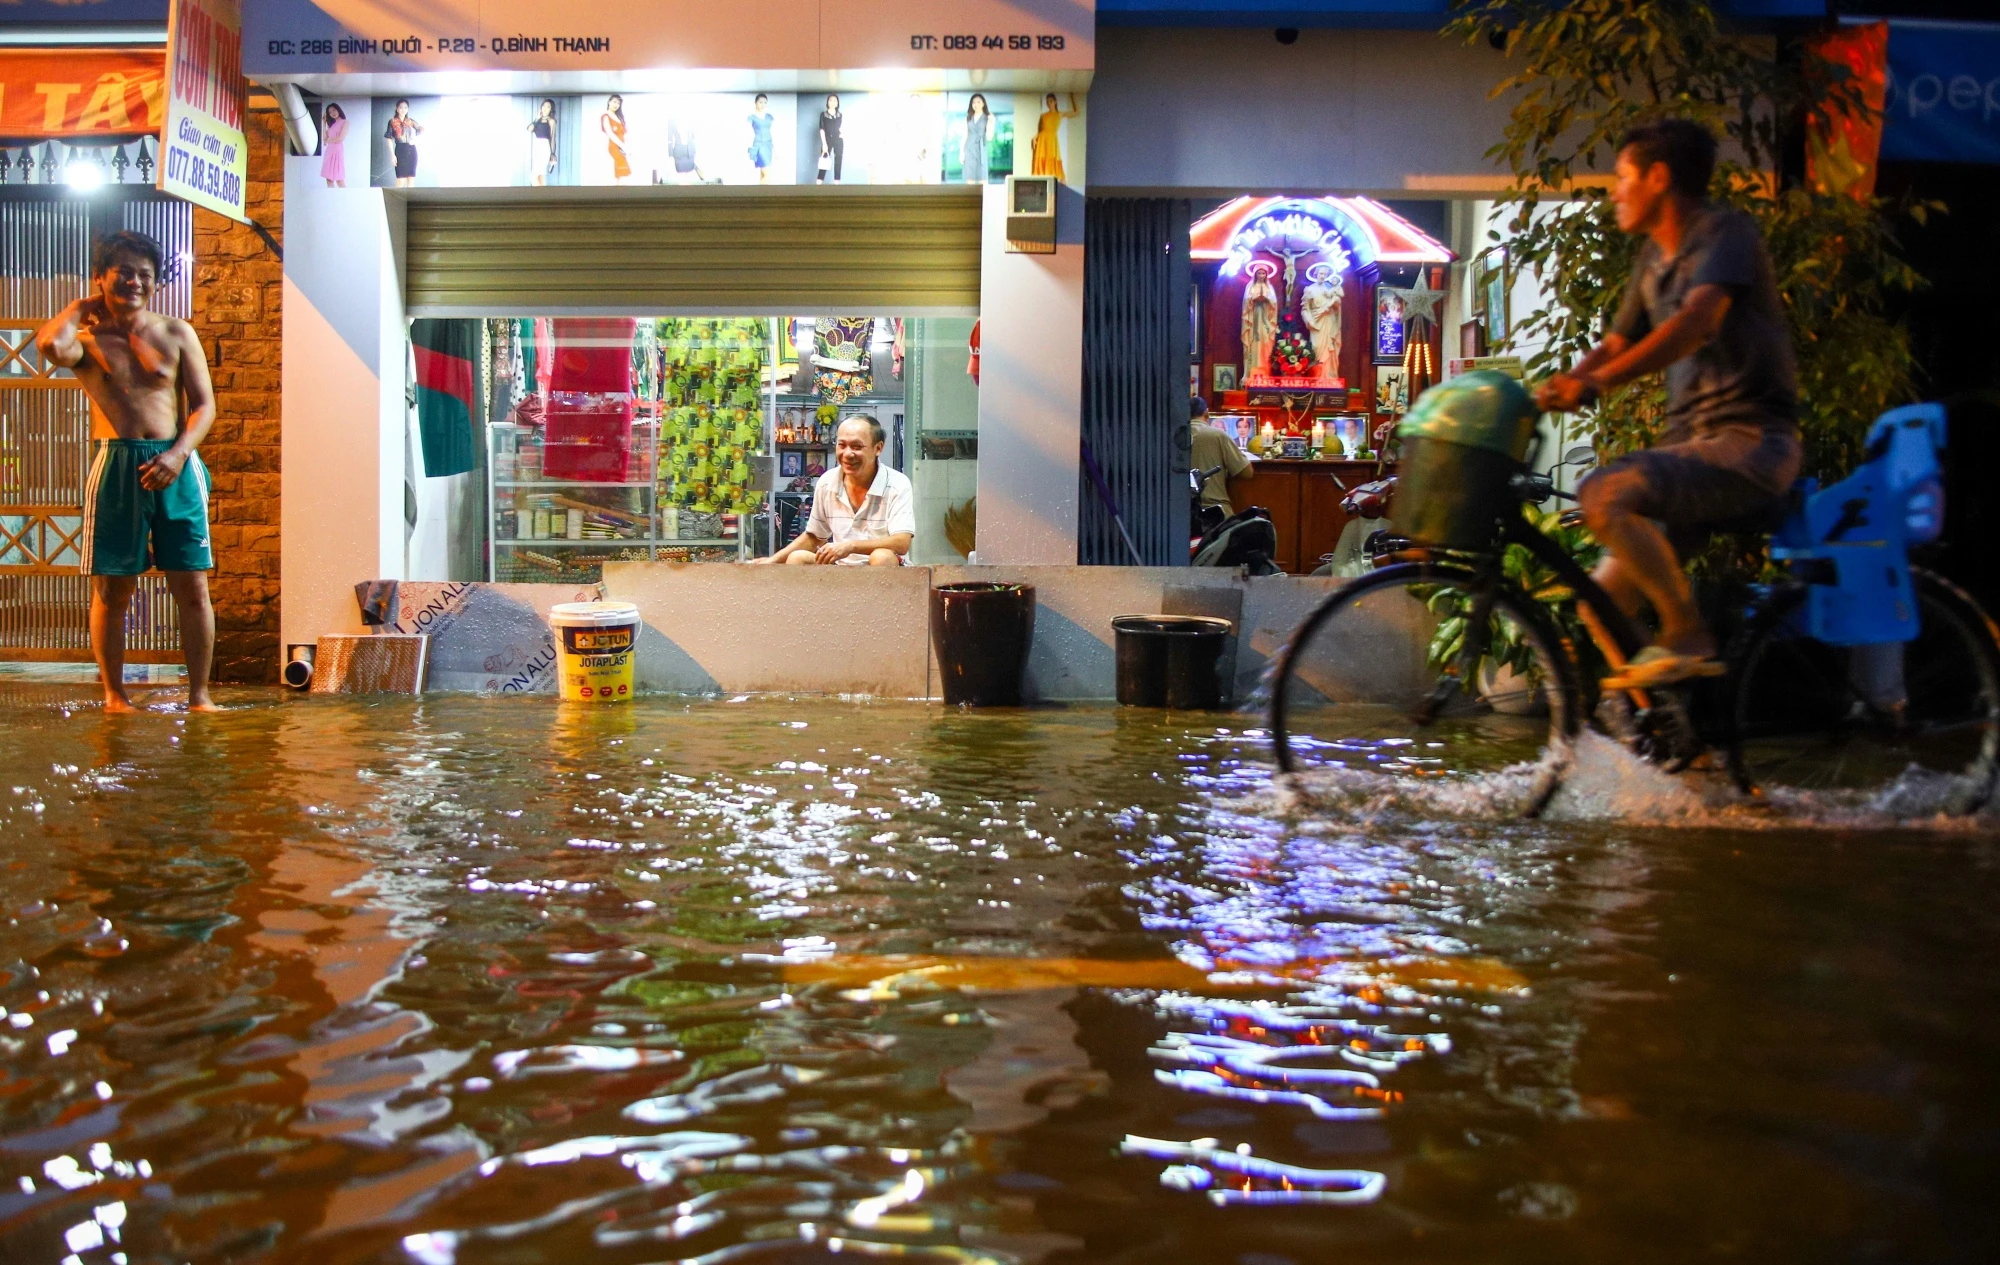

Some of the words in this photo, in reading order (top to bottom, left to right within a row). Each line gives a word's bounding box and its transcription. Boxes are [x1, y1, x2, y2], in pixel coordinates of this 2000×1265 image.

[175, 0, 212, 112] CƠM
[268, 40, 296, 55] ĐC:
[300, 39, 333, 54] 286
[338, 35, 377, 54] BÌNH
[438, 38, 475, 53] P.28
[491, 33, 547, 55] Q.BÌNH
[552, 37, 610, 55] THẠNH
[911, 35, 938, 50] ĐT:
[943, 35, 977, 50] 083
[981, 35, 1003, 50] 44
[1008, 35, 1031, 50] 58
[1036, 35, 1065, 50] 193
[179, 116, 201, 147] Giao
[203, 133, 221, 156] cơm
[222, 143, 238, 167] gọi
[168, 145, 241, 206] 077.88.59.808
[394, 582, 471, 634] LIONAL
[592, 633, 629, 647] JOTUN
[580, 654, 628, 668] JOTAPLAST
